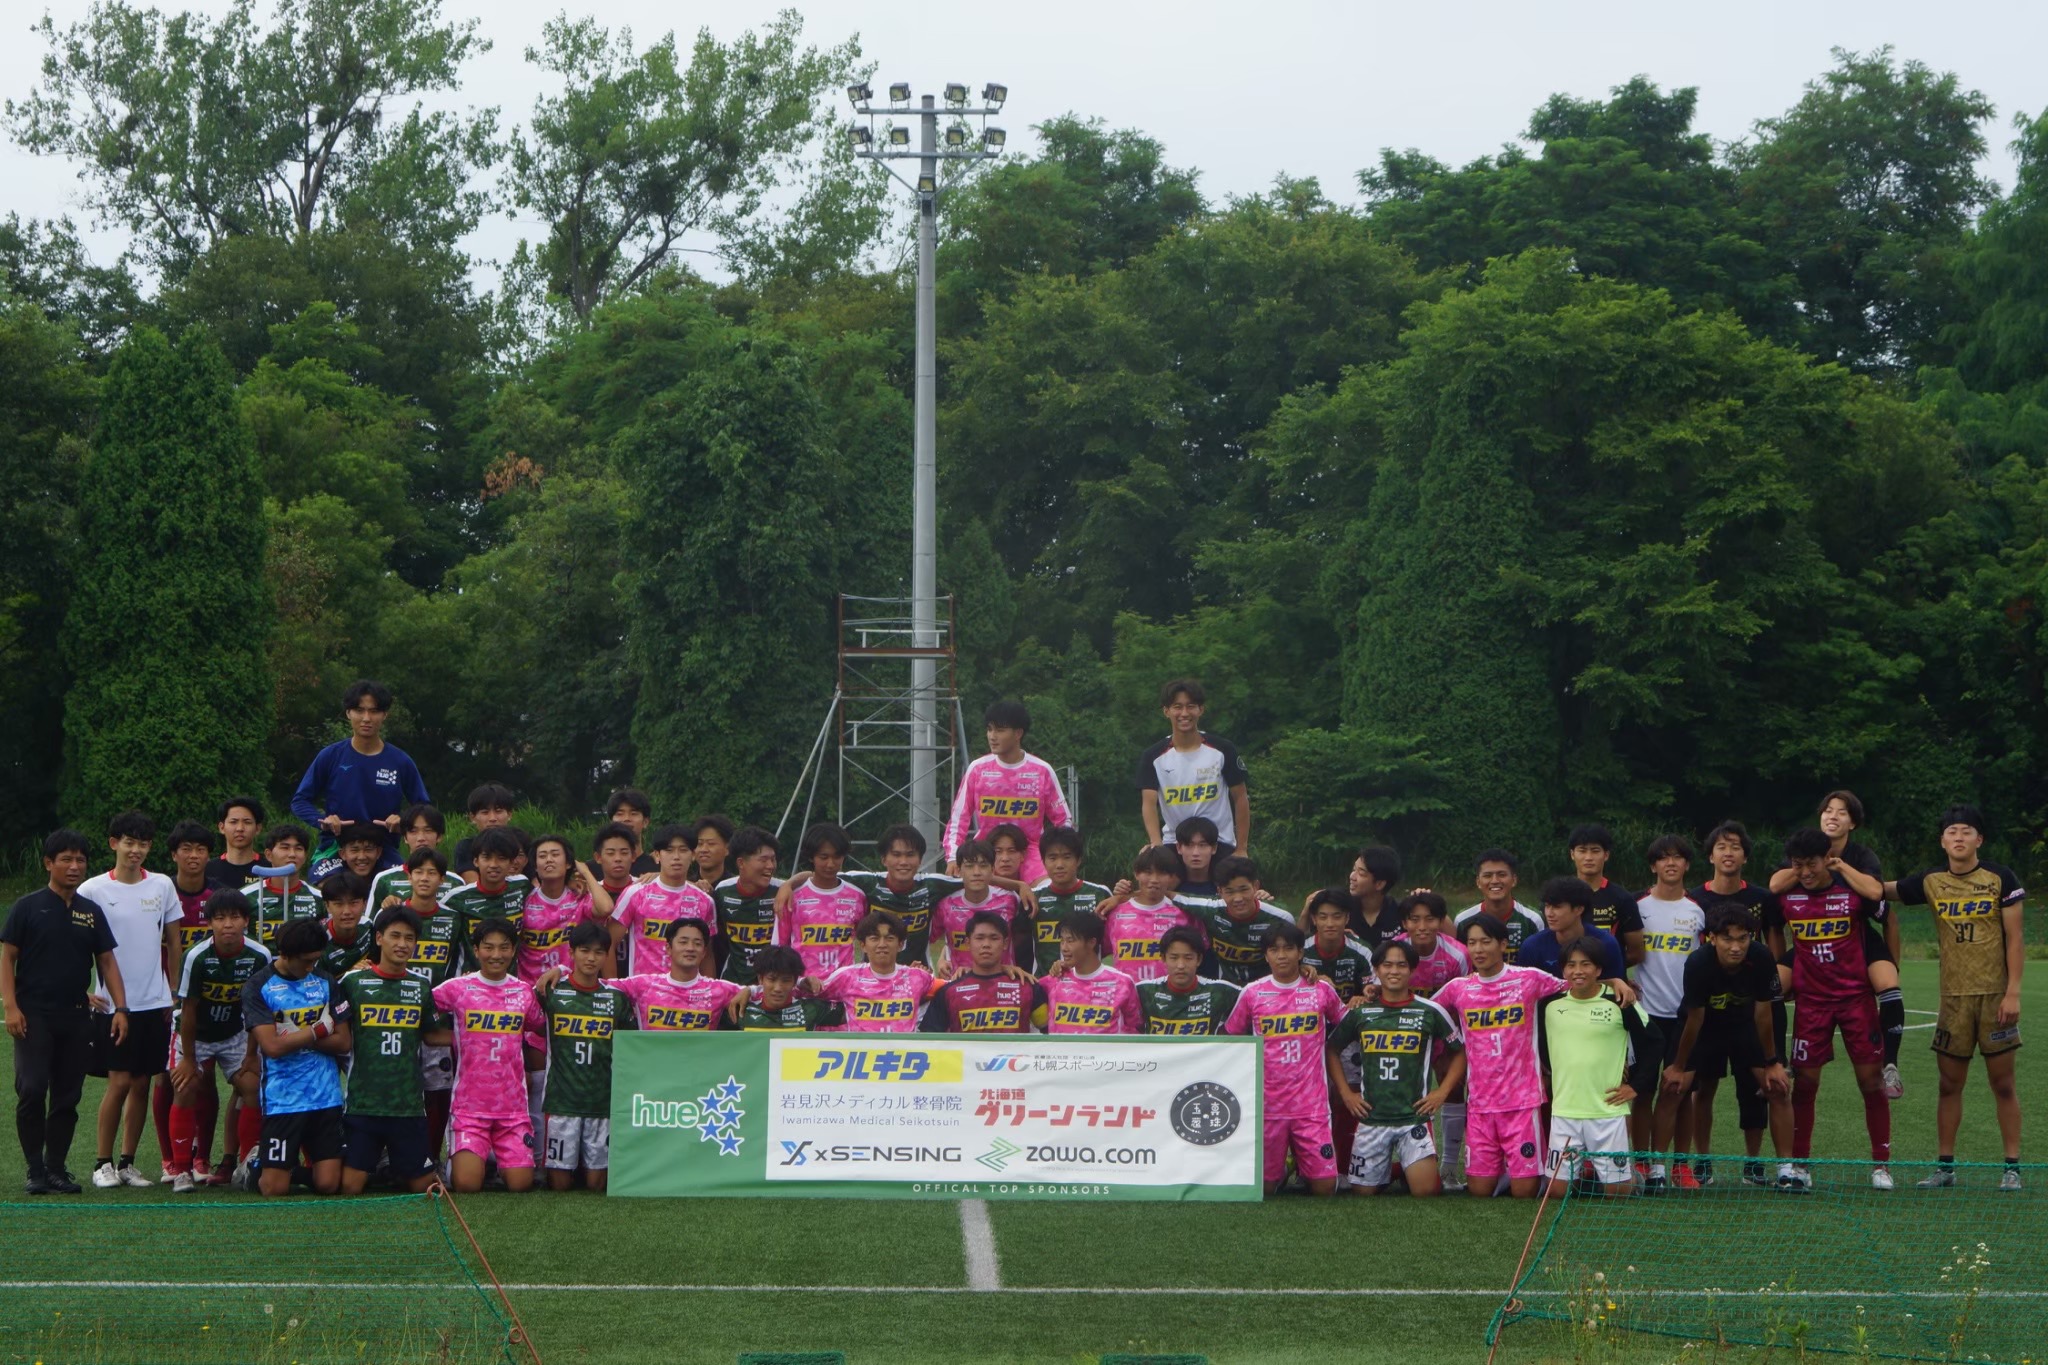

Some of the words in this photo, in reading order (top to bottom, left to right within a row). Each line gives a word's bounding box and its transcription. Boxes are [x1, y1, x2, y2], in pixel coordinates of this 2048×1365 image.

[1166, 784, 1218, 804] アルキタ
[981, 799, 1038, 816] アルキタ
[72, 910, 87, 920] hue
[1594, 907, 1607, 915] hue
[1826, 903, 1840, 911] hue
[1938, 901, 1992, 917] アルキタ
[1381, 930, 1395, 938] hue
[1792, 920, 1850, 937] アルキタ
[1955, 923, 1974, 944] 37
[1812, 943, 1835, 964] 45
[401, 989, 414, 997] hue
[997, 991, 1011, 999] hue
[1295, 997, 1309, 1005] hue
[210, 1005, 232, 1022] 46
[362, 1007, 420, 1025] アルキタ
[782, 1013, 796, 1021] hue
[857, 1001, 913, 1018] アルキタ
[1056, 1005, 1112, 1024] アルキタ
[1188, 1005, 1203, 1013] hue
[1466, 1007, 1523, 1027] アルキタ
[467, 1013, 523, 1031] アルキタ
[554, 1018, 613, 1036] アルキタ
[650, 1008, 711, 1029] アルキタ
[962, 1009, 1018, 1031] アルキタ
[1262, 1015, 1318, 1035] アルキタ
[1399, 1016, 1413, 1025] hue
[381, 1031, 402, 1055] 26
[490, 1037, 502, 1062] 2
[1281, 1039, 1302, 1064] 33
[1364, 1034, 1419, 1051] アルキタ
[1491, 1033, 1501, 1057] 3
[575, 1041, 592, 1065] 51
[814, 1051, 931, 1080] アルキタ
[1033, 1060, 1158, 1072] 札幌スポーツクリニック
[1379, 1057, 1399, 1081] 52
[780, 1094, 962, 1111] 岩見沢メディカル整骨院
[979, 1088, 1026, 1100] 北海道
[632, 1094, 699, 1128] hue
[974, 1101, 1156, 1128] グリーンランド
[782, 1116, 845, 1125] Iwamizawa
[850, 1116, 895, 1126] Medical
[899, 1117, 960, 1127] Seikotsuin
[268, 1138, 286, 1162] 21
[548, 1138, 564, 1162] 51
[814, 1146, 962, 1162] xSENSING
[1026, 1146, 1156, 1164] zawa.com
[913, 1183, 979, 1193] OFFICAL
[990, 1185, 1019, 1194] TOP
[1028, 1185, 1110, 1195] SPONSORS
